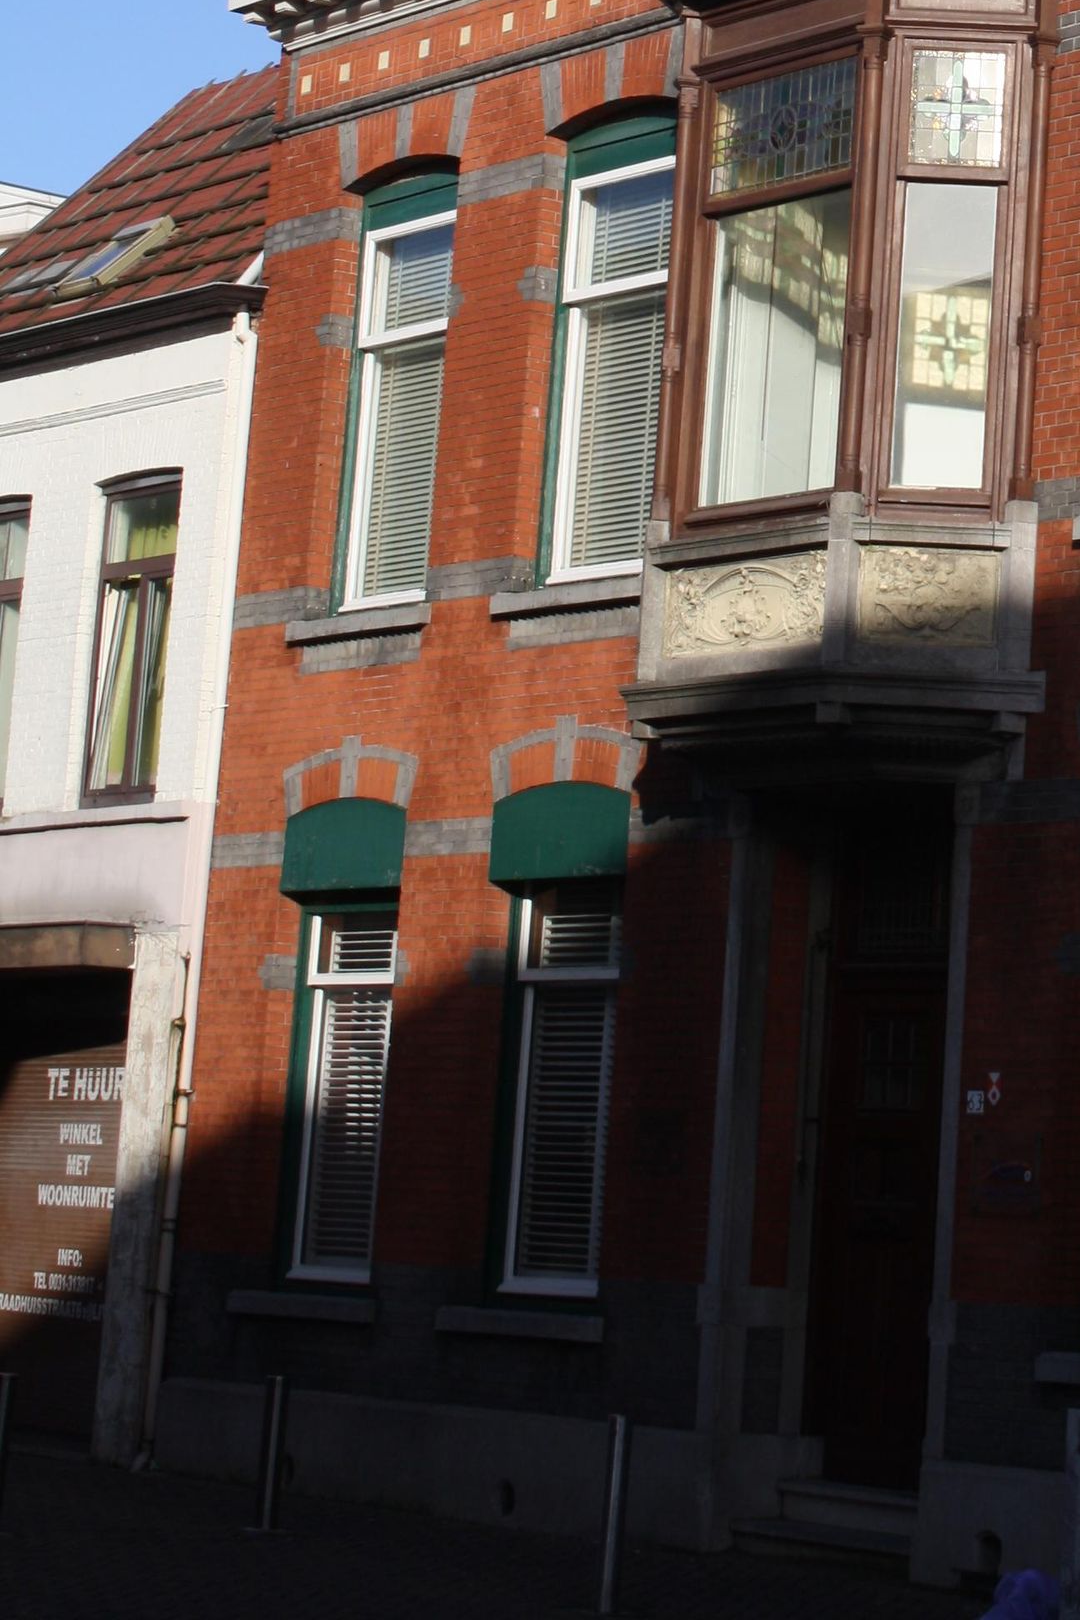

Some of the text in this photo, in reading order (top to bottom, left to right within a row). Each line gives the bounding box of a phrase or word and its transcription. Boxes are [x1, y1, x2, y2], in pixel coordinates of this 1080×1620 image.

[47, 1067, 70, 1100] TE
[60, 1123, 103, 1145] WINKEL
[66, 1154, 91, 1176] MET
[38, 1184, 116, 1209] WOONRUIMTE
[57, 1248, 83, 1268] INFO:
[33, 1271, 47, 1290] TEL
